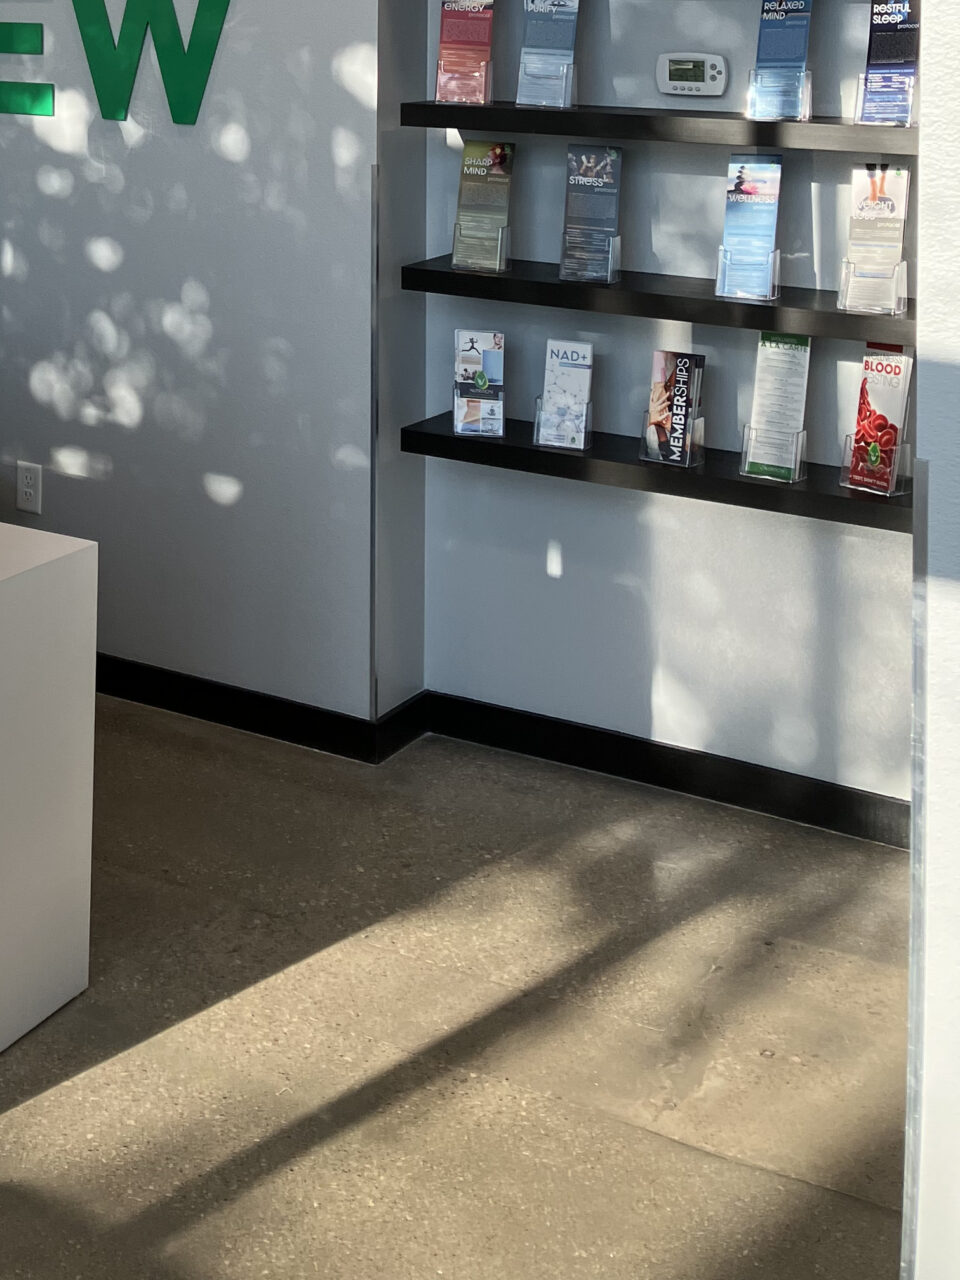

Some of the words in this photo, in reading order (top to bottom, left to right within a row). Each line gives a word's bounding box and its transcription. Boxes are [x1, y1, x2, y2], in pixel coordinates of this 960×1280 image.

[550, 348, 588, 362] NAD+
[864, 359, 902, 376] BLOOD
[668, 358, 690, 462] MEMBERSHIPS
